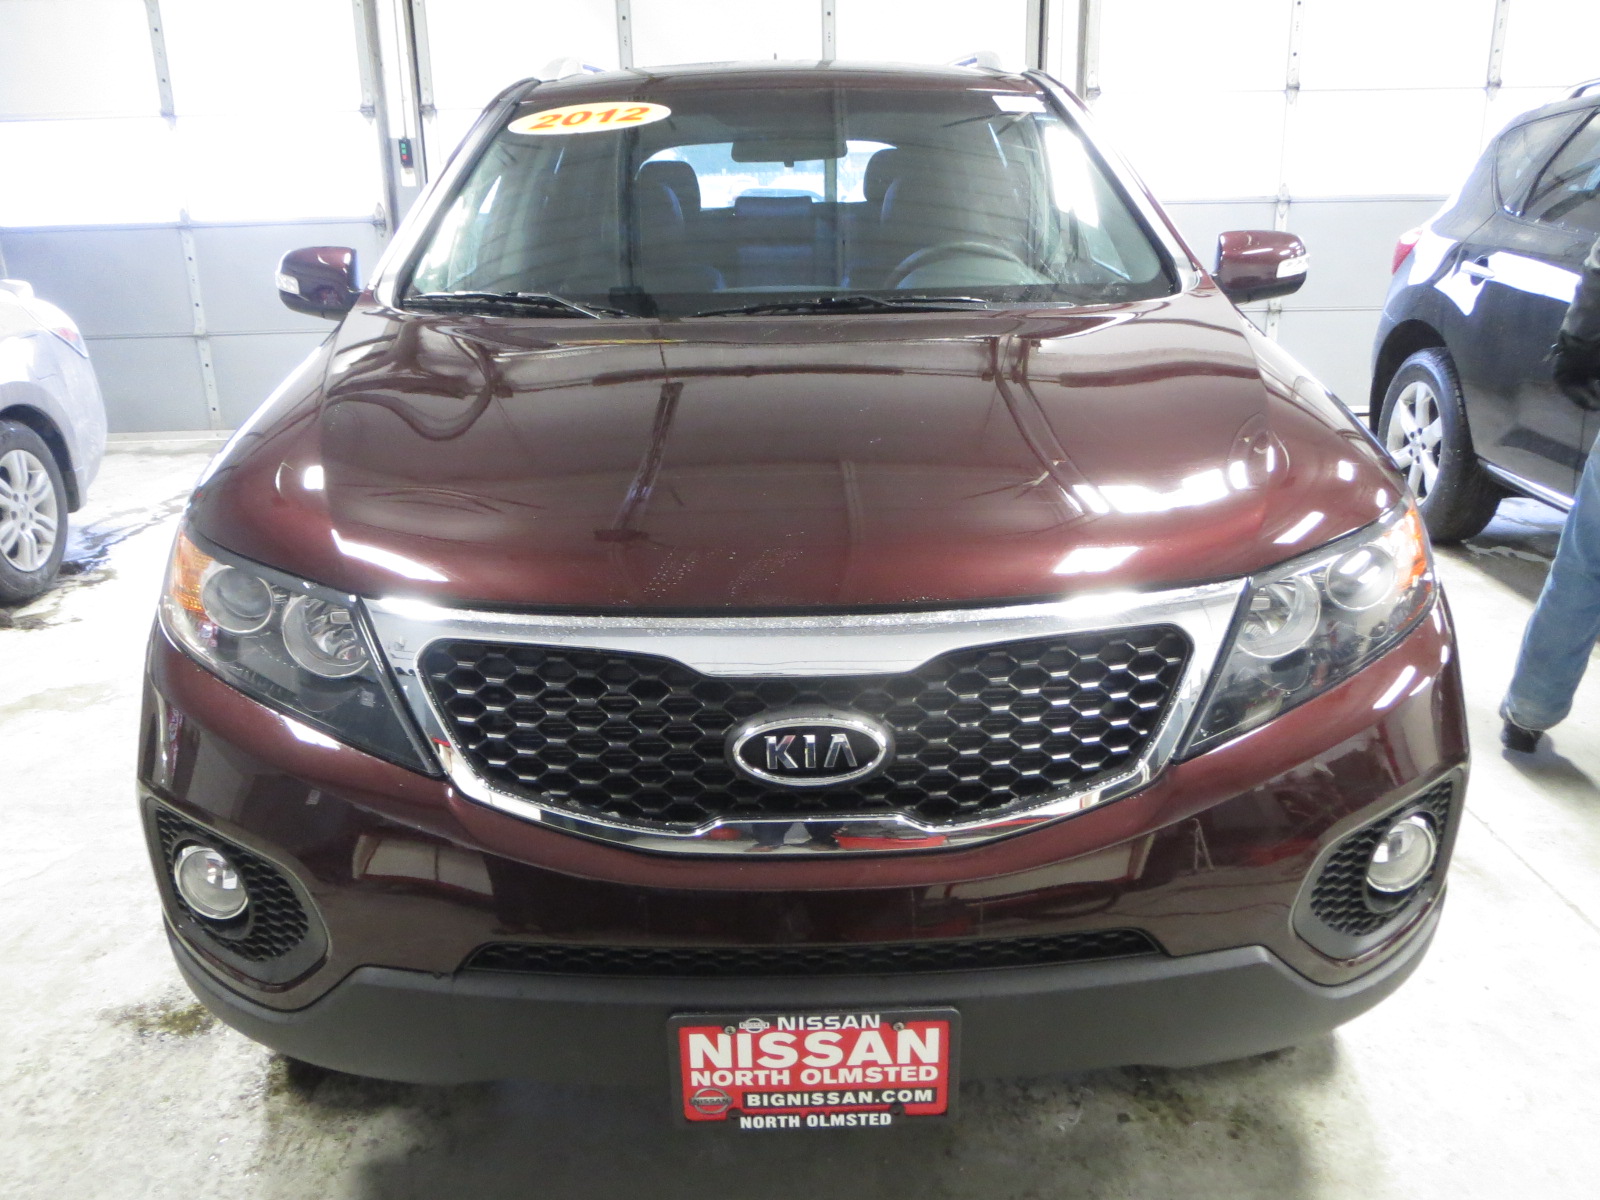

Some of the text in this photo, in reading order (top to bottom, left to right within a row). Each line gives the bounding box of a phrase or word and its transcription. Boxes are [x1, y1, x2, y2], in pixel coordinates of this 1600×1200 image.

[529, 107, 650, 130] 2012
[764, 734, 857, 769] KIA
[777, 1014, 880, 1031] NISSAN
[689, 1028, 939, 1068] NISSAN
[691, 1065, 938, 1086] NORTH OLMSTED
[747, 1089, 933, 1107] BIGNISSAN.COM
[740, 1113, 892, 1129] NORTH OLMSTED
